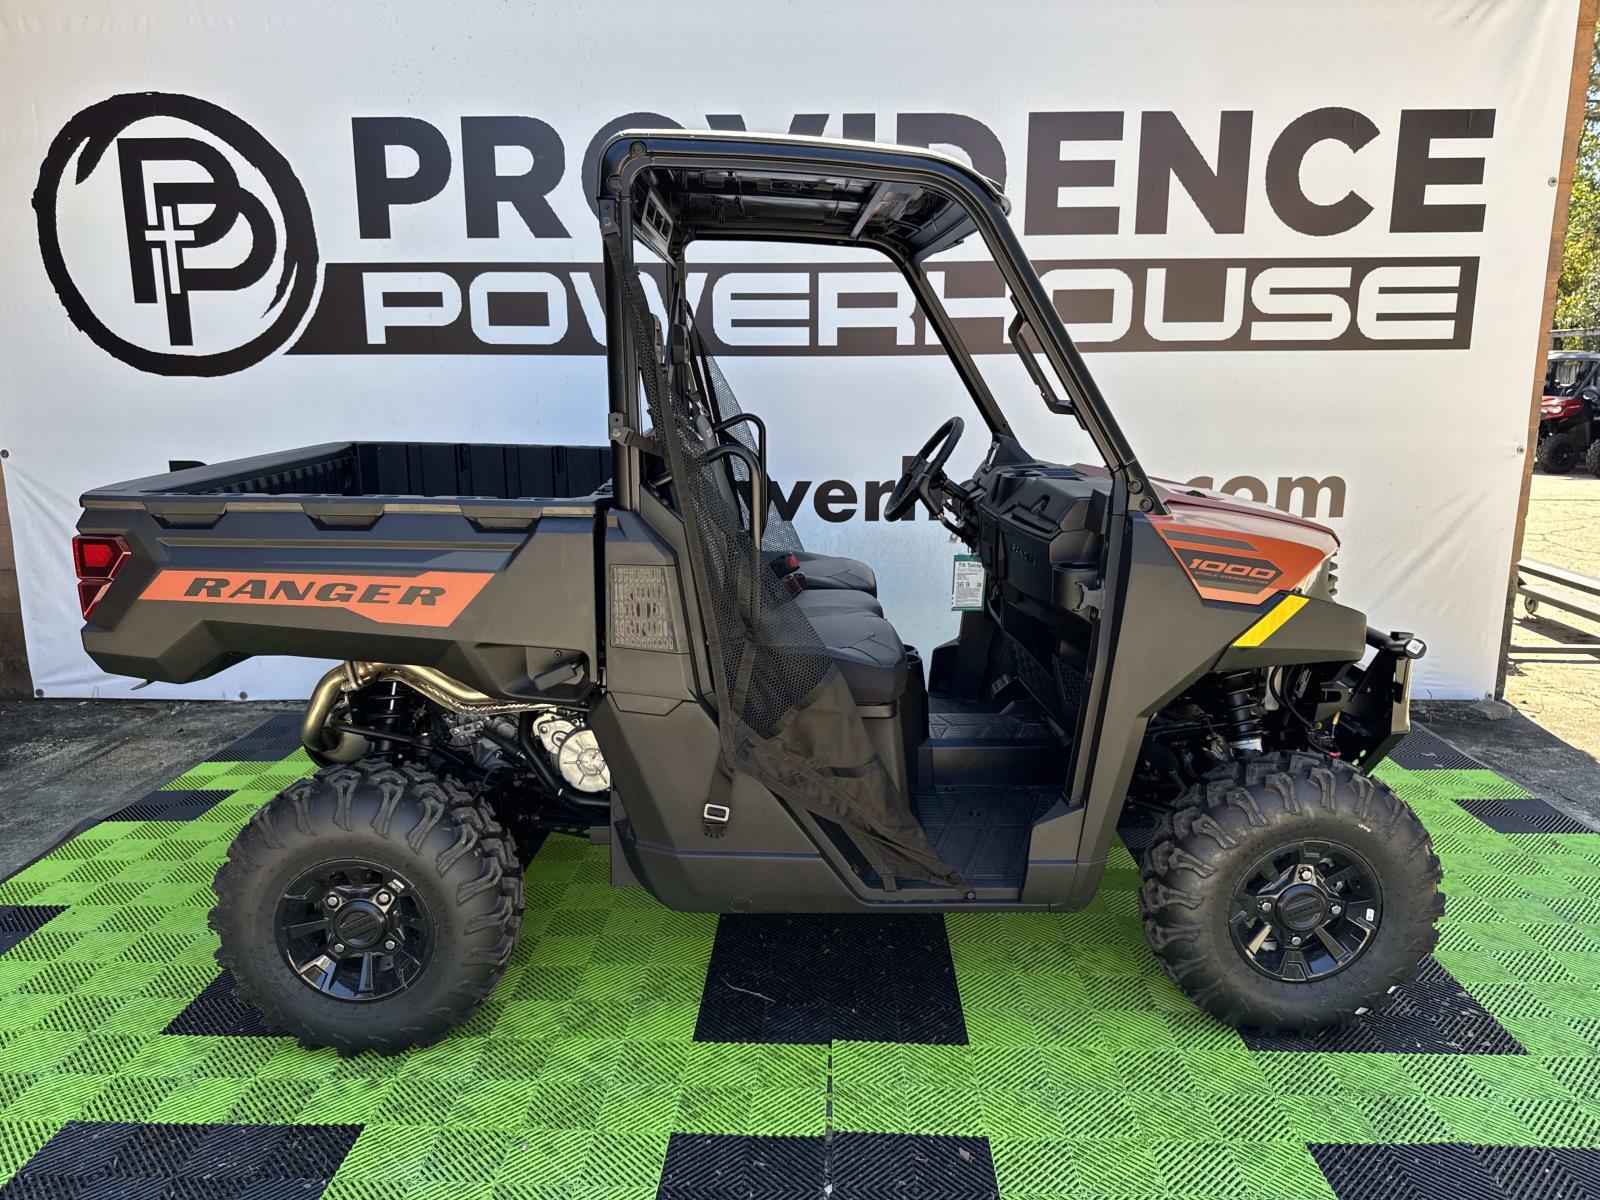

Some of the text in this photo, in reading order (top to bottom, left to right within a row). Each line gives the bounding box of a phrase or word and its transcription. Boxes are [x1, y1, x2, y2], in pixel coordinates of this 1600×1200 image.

[352, 106, 1496, 240] PRENCE
[1190, 558, 1276, 579] 1000
[184, 577, 446, 606] RANGER
